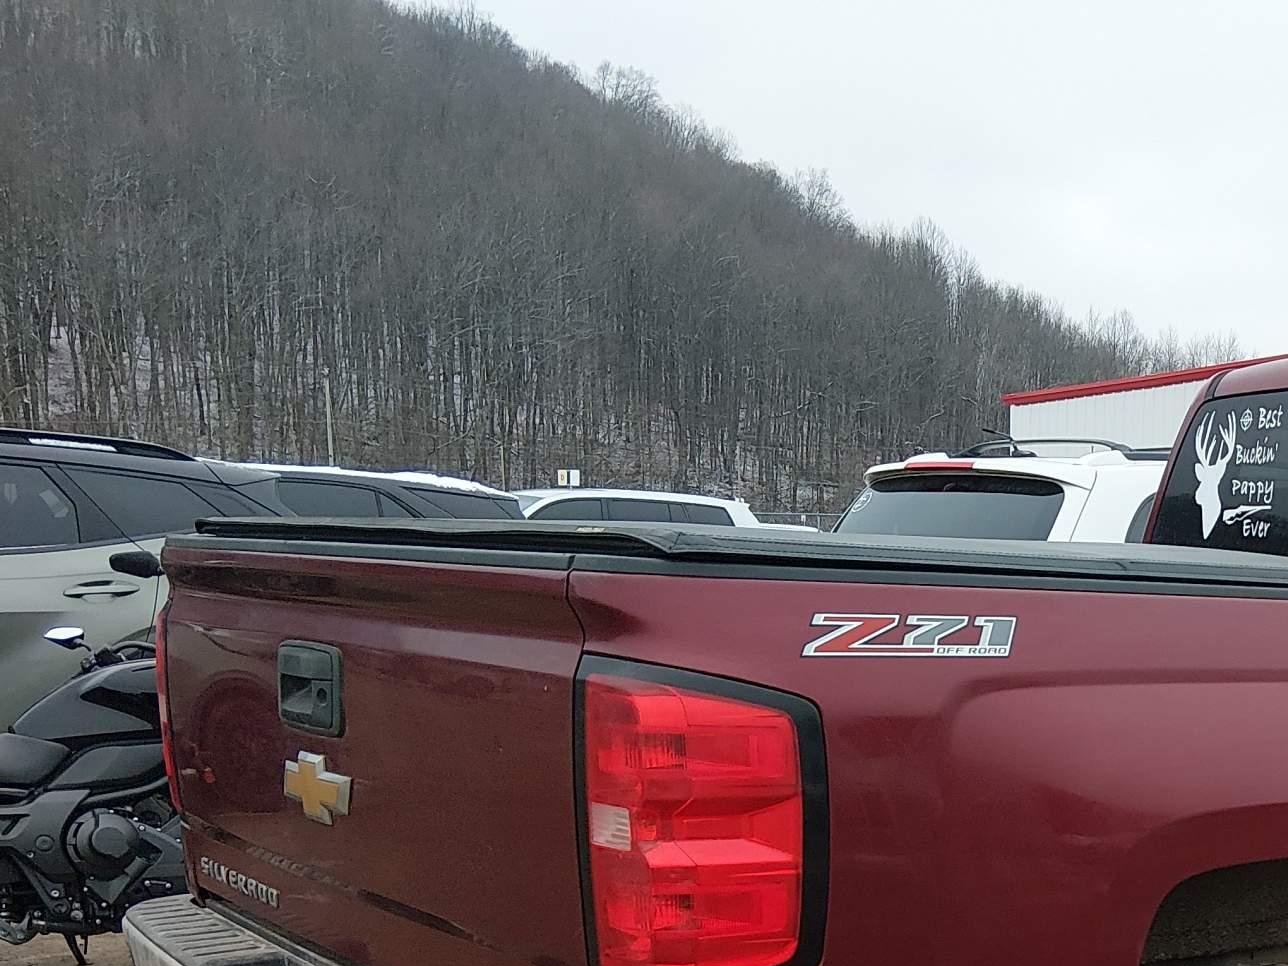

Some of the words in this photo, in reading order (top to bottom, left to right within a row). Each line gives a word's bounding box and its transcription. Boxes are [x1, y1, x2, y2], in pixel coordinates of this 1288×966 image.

[1258, 405, 1284, 430] Best
[1235, 437, 1279, 465] Buckin'
[1231, 479, 1275, 504] Pappy
[1242, 519, 1271, 538] Ever
[800, 612, 1018, 658] Z71
[936, 647, 966, 655] OFF
[967, 647, 1008, 655] ROAD
[200, 856, 280, 909] SILVERADO
